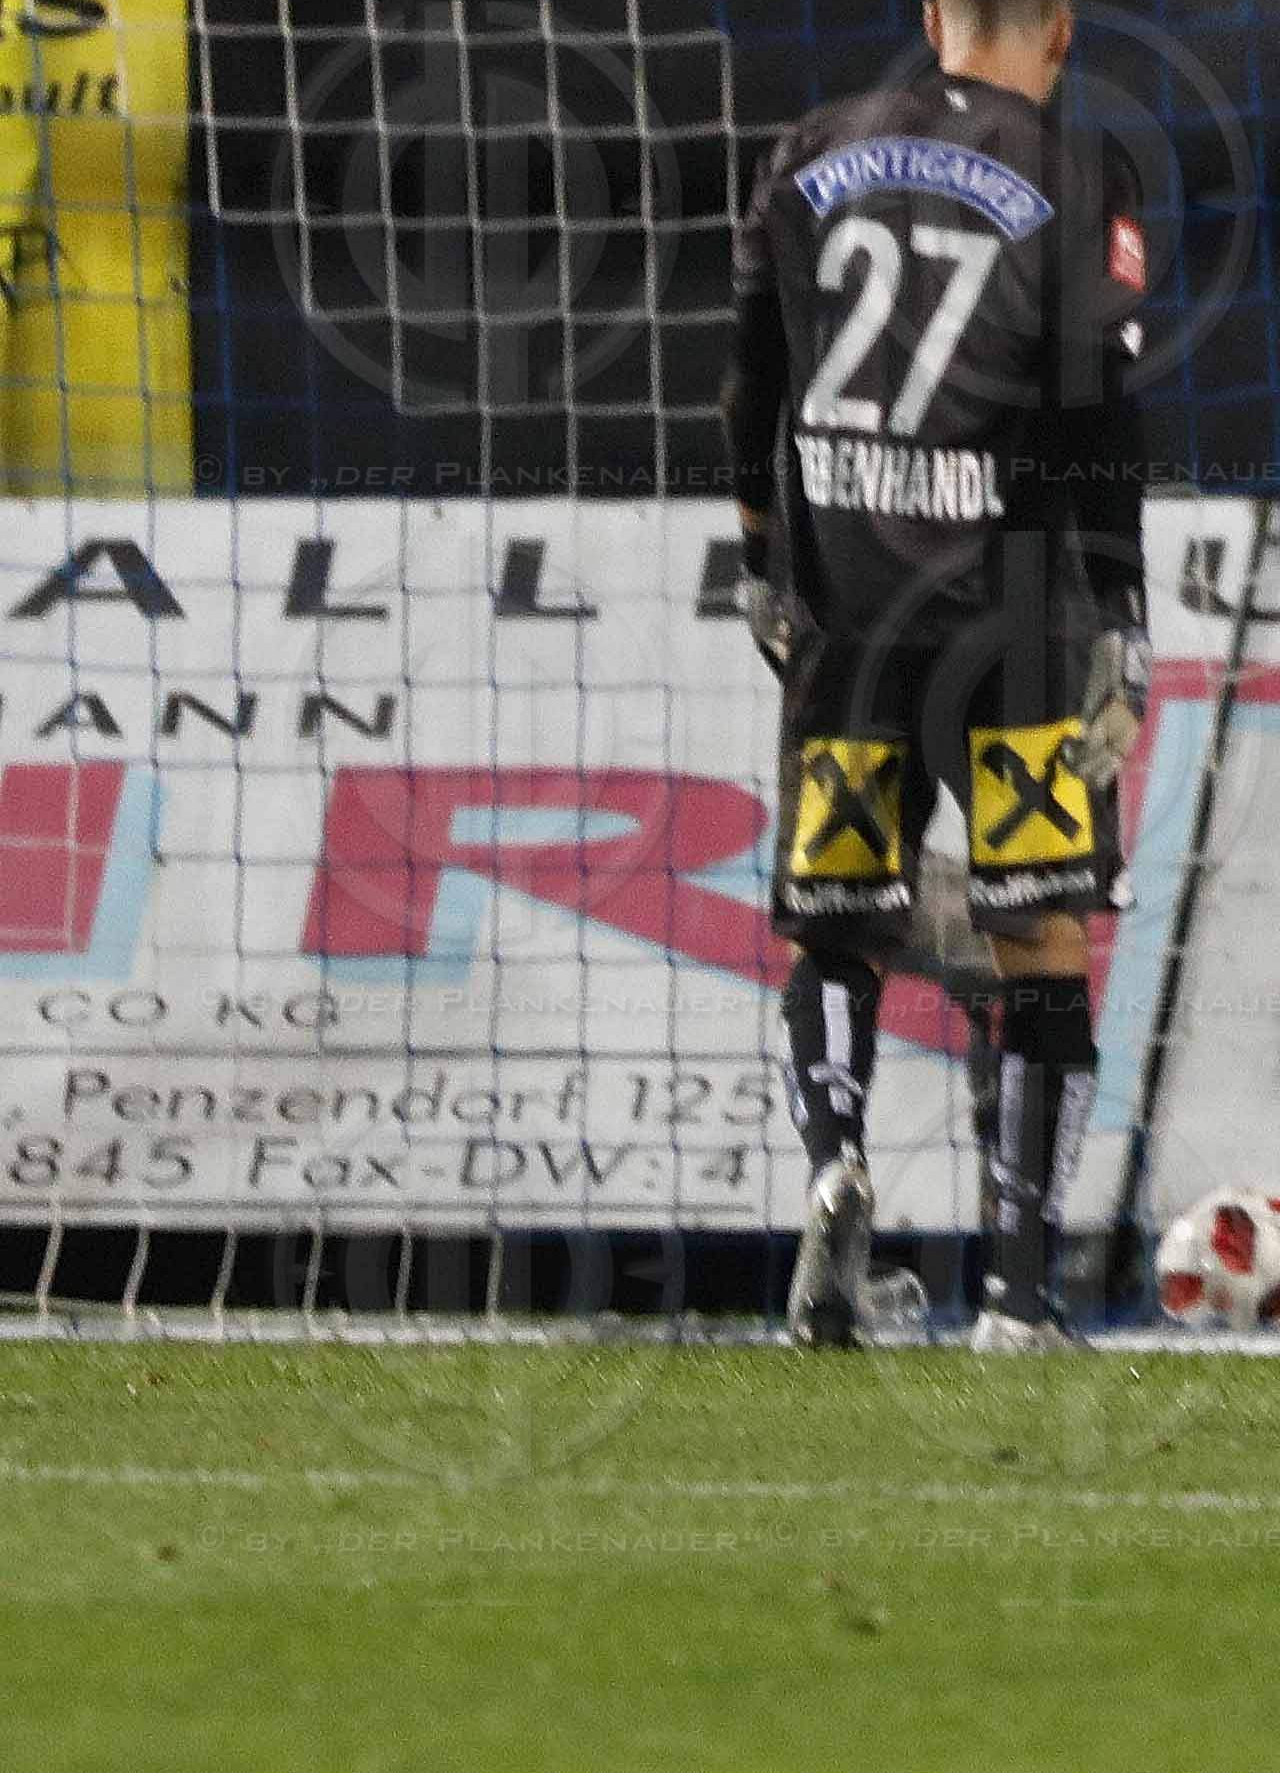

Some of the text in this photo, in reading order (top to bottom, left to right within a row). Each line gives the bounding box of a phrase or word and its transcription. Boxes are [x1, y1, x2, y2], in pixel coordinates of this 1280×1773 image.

[801, 215, 1001, 436] 27
[0, 691, 398, 739] ANN
[63, 1067, 777, 1125] Penzendorf 125
[6, 1133, 195, 1189] 845
[702, 1137, 750, 1187] 4
